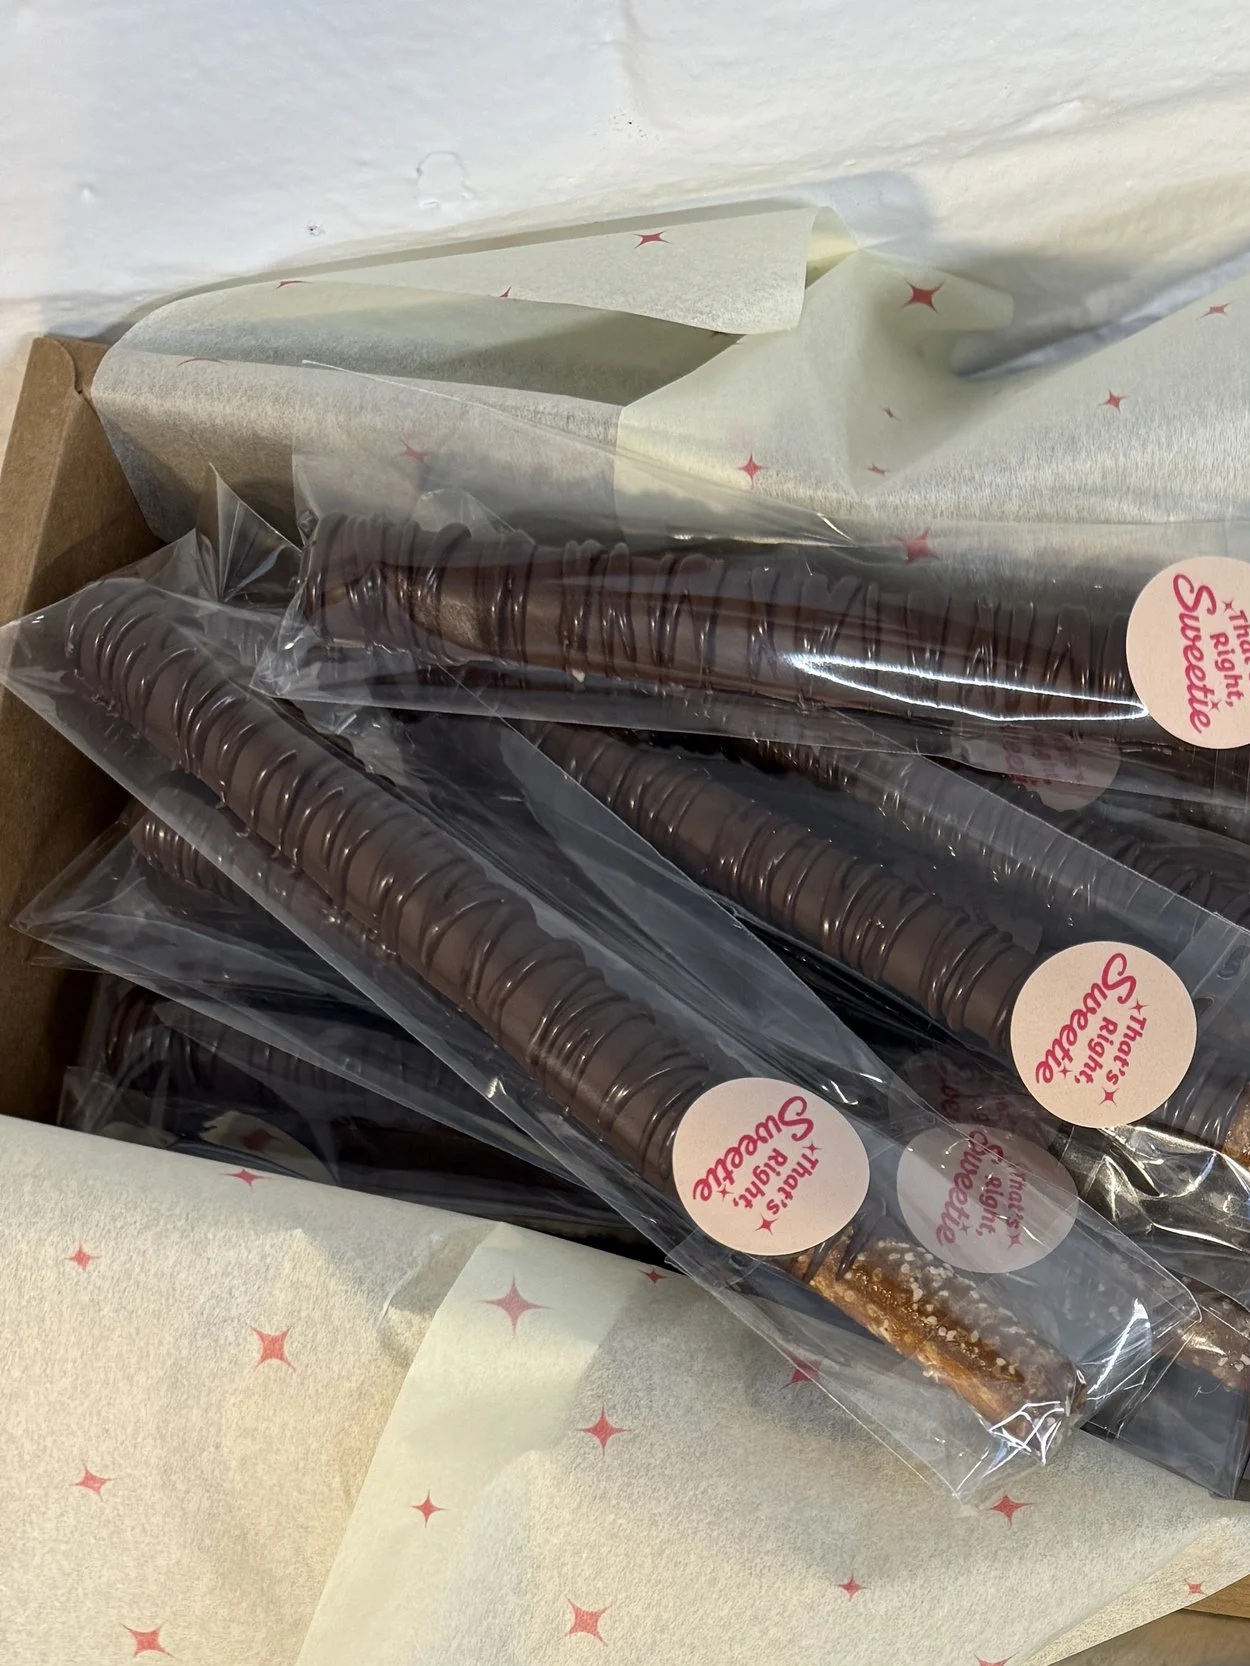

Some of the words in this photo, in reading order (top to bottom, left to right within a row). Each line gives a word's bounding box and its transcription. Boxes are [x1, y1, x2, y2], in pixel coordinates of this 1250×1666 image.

[1173, 573, 1217, 733] Sweetie
[1210, 632, 1245, 708] Right,
[1036, 952, 1136, 1084] Sweetie
[1075, 1017, 1118, 1084] Right,
[1107, 1014, 1147, 1086] That's
[692, 1096, 814, 1202] Sweetie
[732, 1148, 788, 1209] Right,
[766, 1150, 819, 1216] That's
